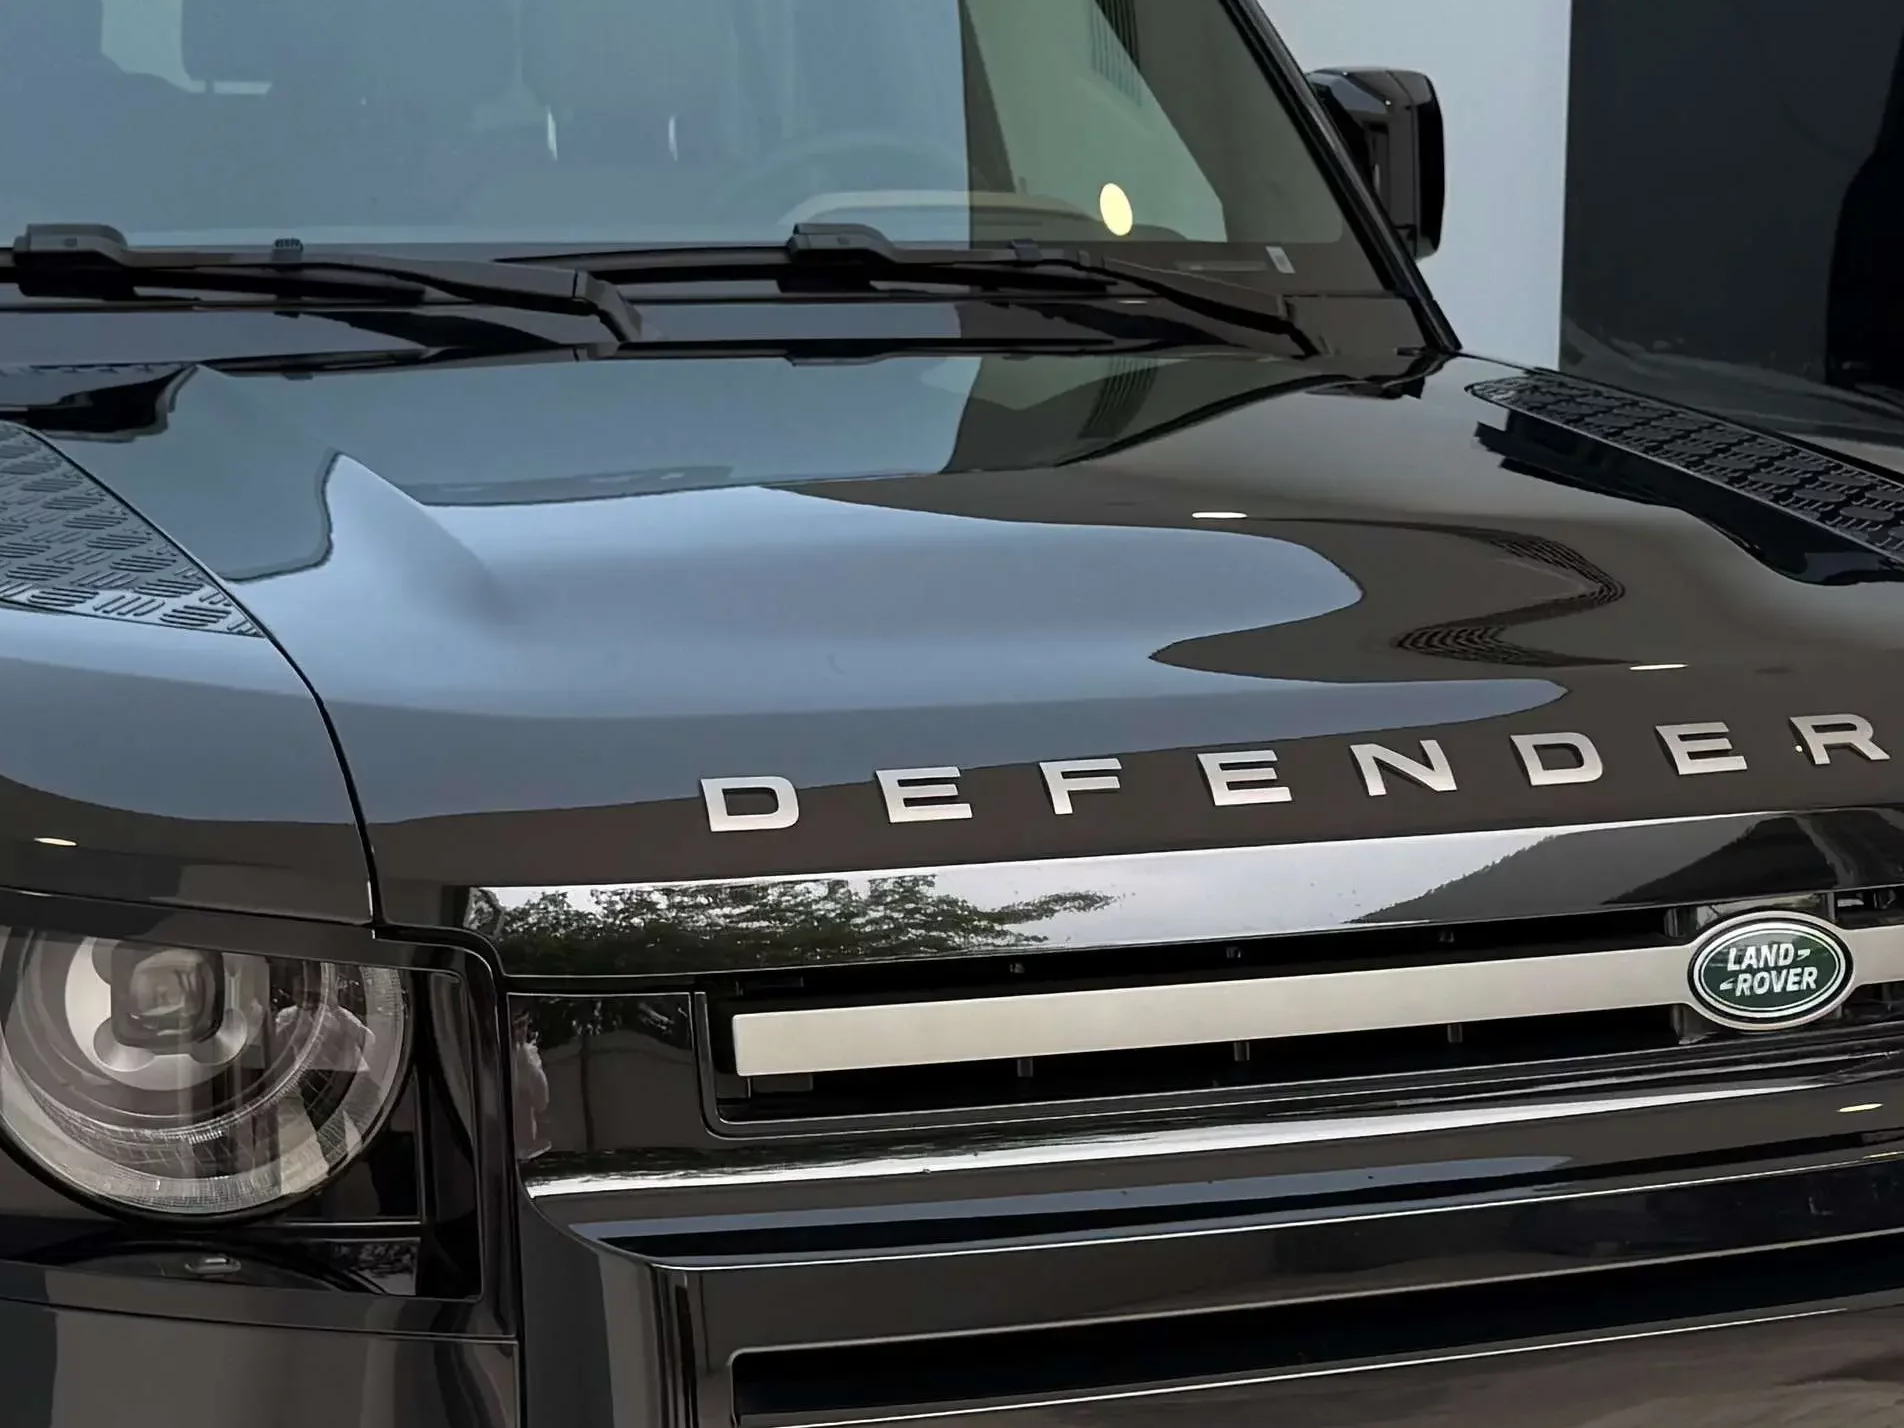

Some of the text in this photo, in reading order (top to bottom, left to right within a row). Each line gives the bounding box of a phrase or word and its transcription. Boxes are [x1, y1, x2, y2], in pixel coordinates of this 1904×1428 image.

[700, 712, 1892, 833] DEFENDER
[1726, 943, 1795, 971] LAND
[1735, 966, 1819, 997] ROVER
